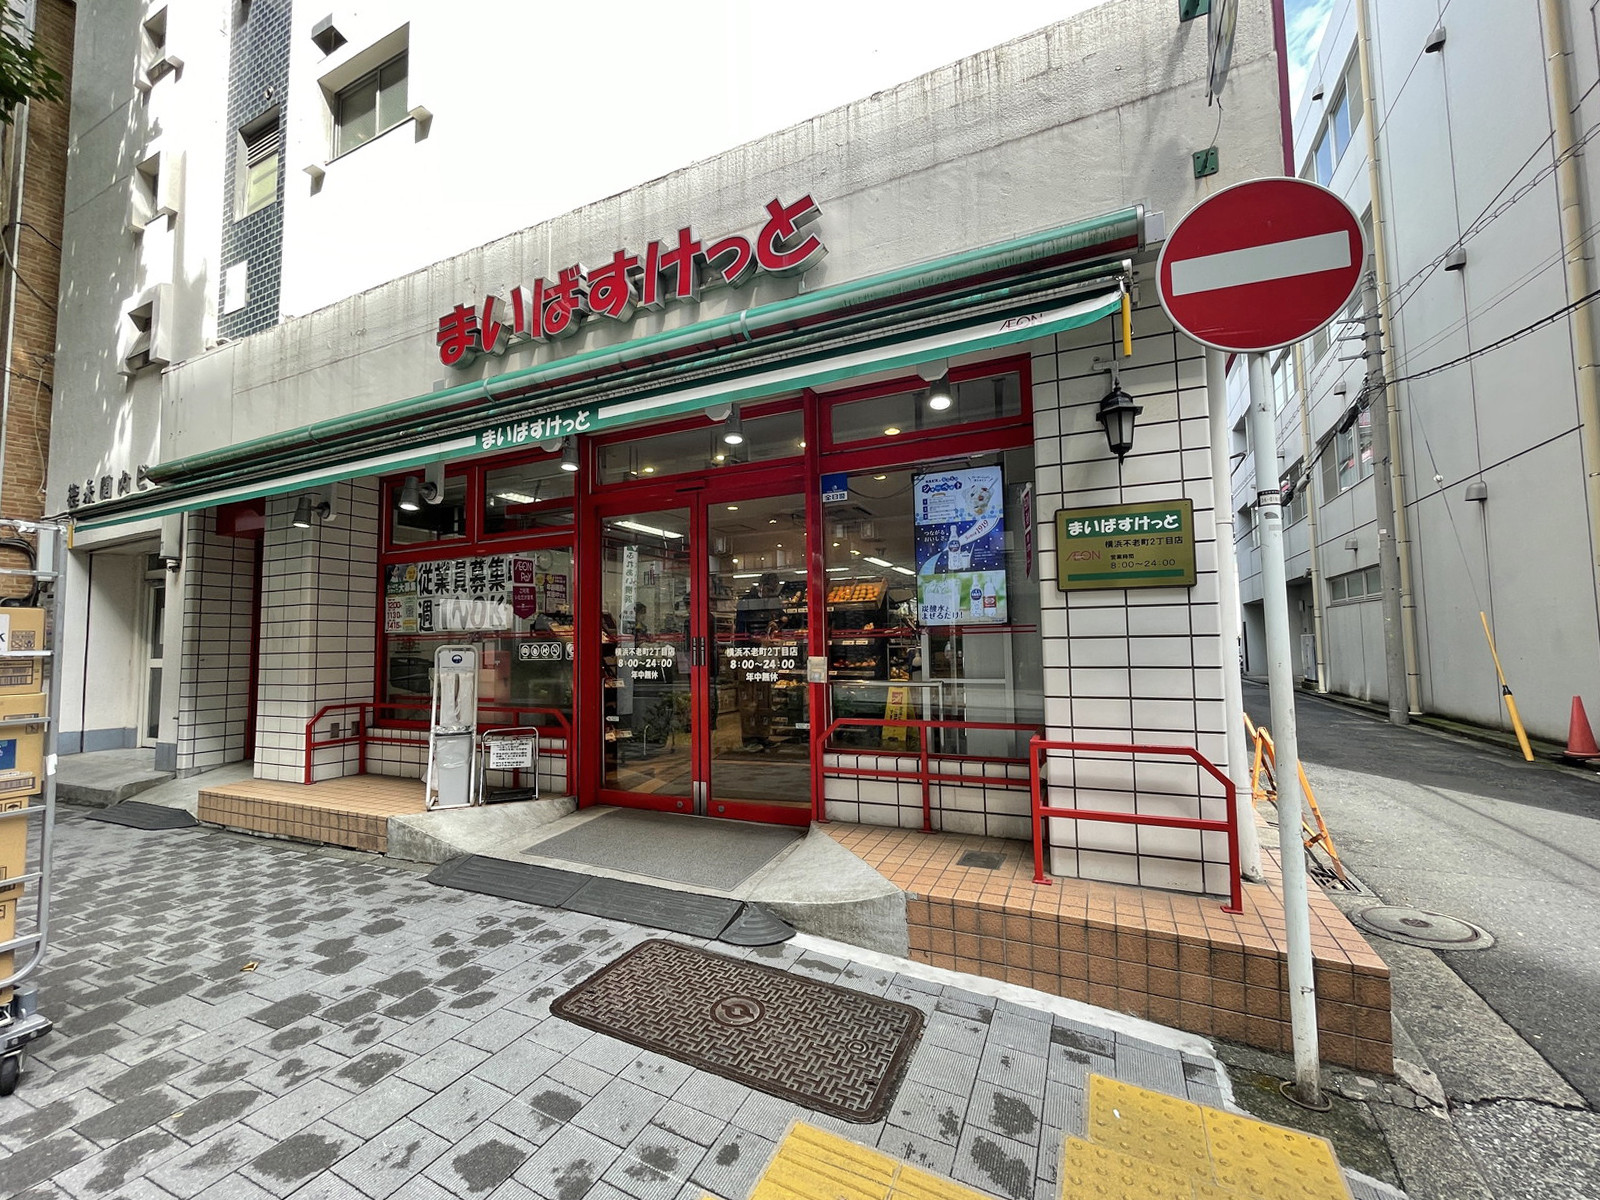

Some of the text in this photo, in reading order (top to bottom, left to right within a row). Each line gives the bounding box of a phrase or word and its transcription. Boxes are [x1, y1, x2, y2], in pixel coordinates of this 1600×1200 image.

[436, 194, 828, 369] まいばすけっと
[481, 410, 591, 450] まいばすけっと
[976, 519, 989, 534] 1919
[1067, 513, 1179, 536] まいばすけっと
[1105, 536, 1183, 549] 横浜不老町2丁目店
[1065, 550, 1102, 562] AEON
[1110, 553, 1135, 561] 営業時間
[615, 647, 675, 657] 横浜不老町2丁目店
[725, 646, 799, 657] 横浜不老町2丁目店
[631, 670, 659, 680] 年中無休
[745, 671, 779, 682] 年中無休
